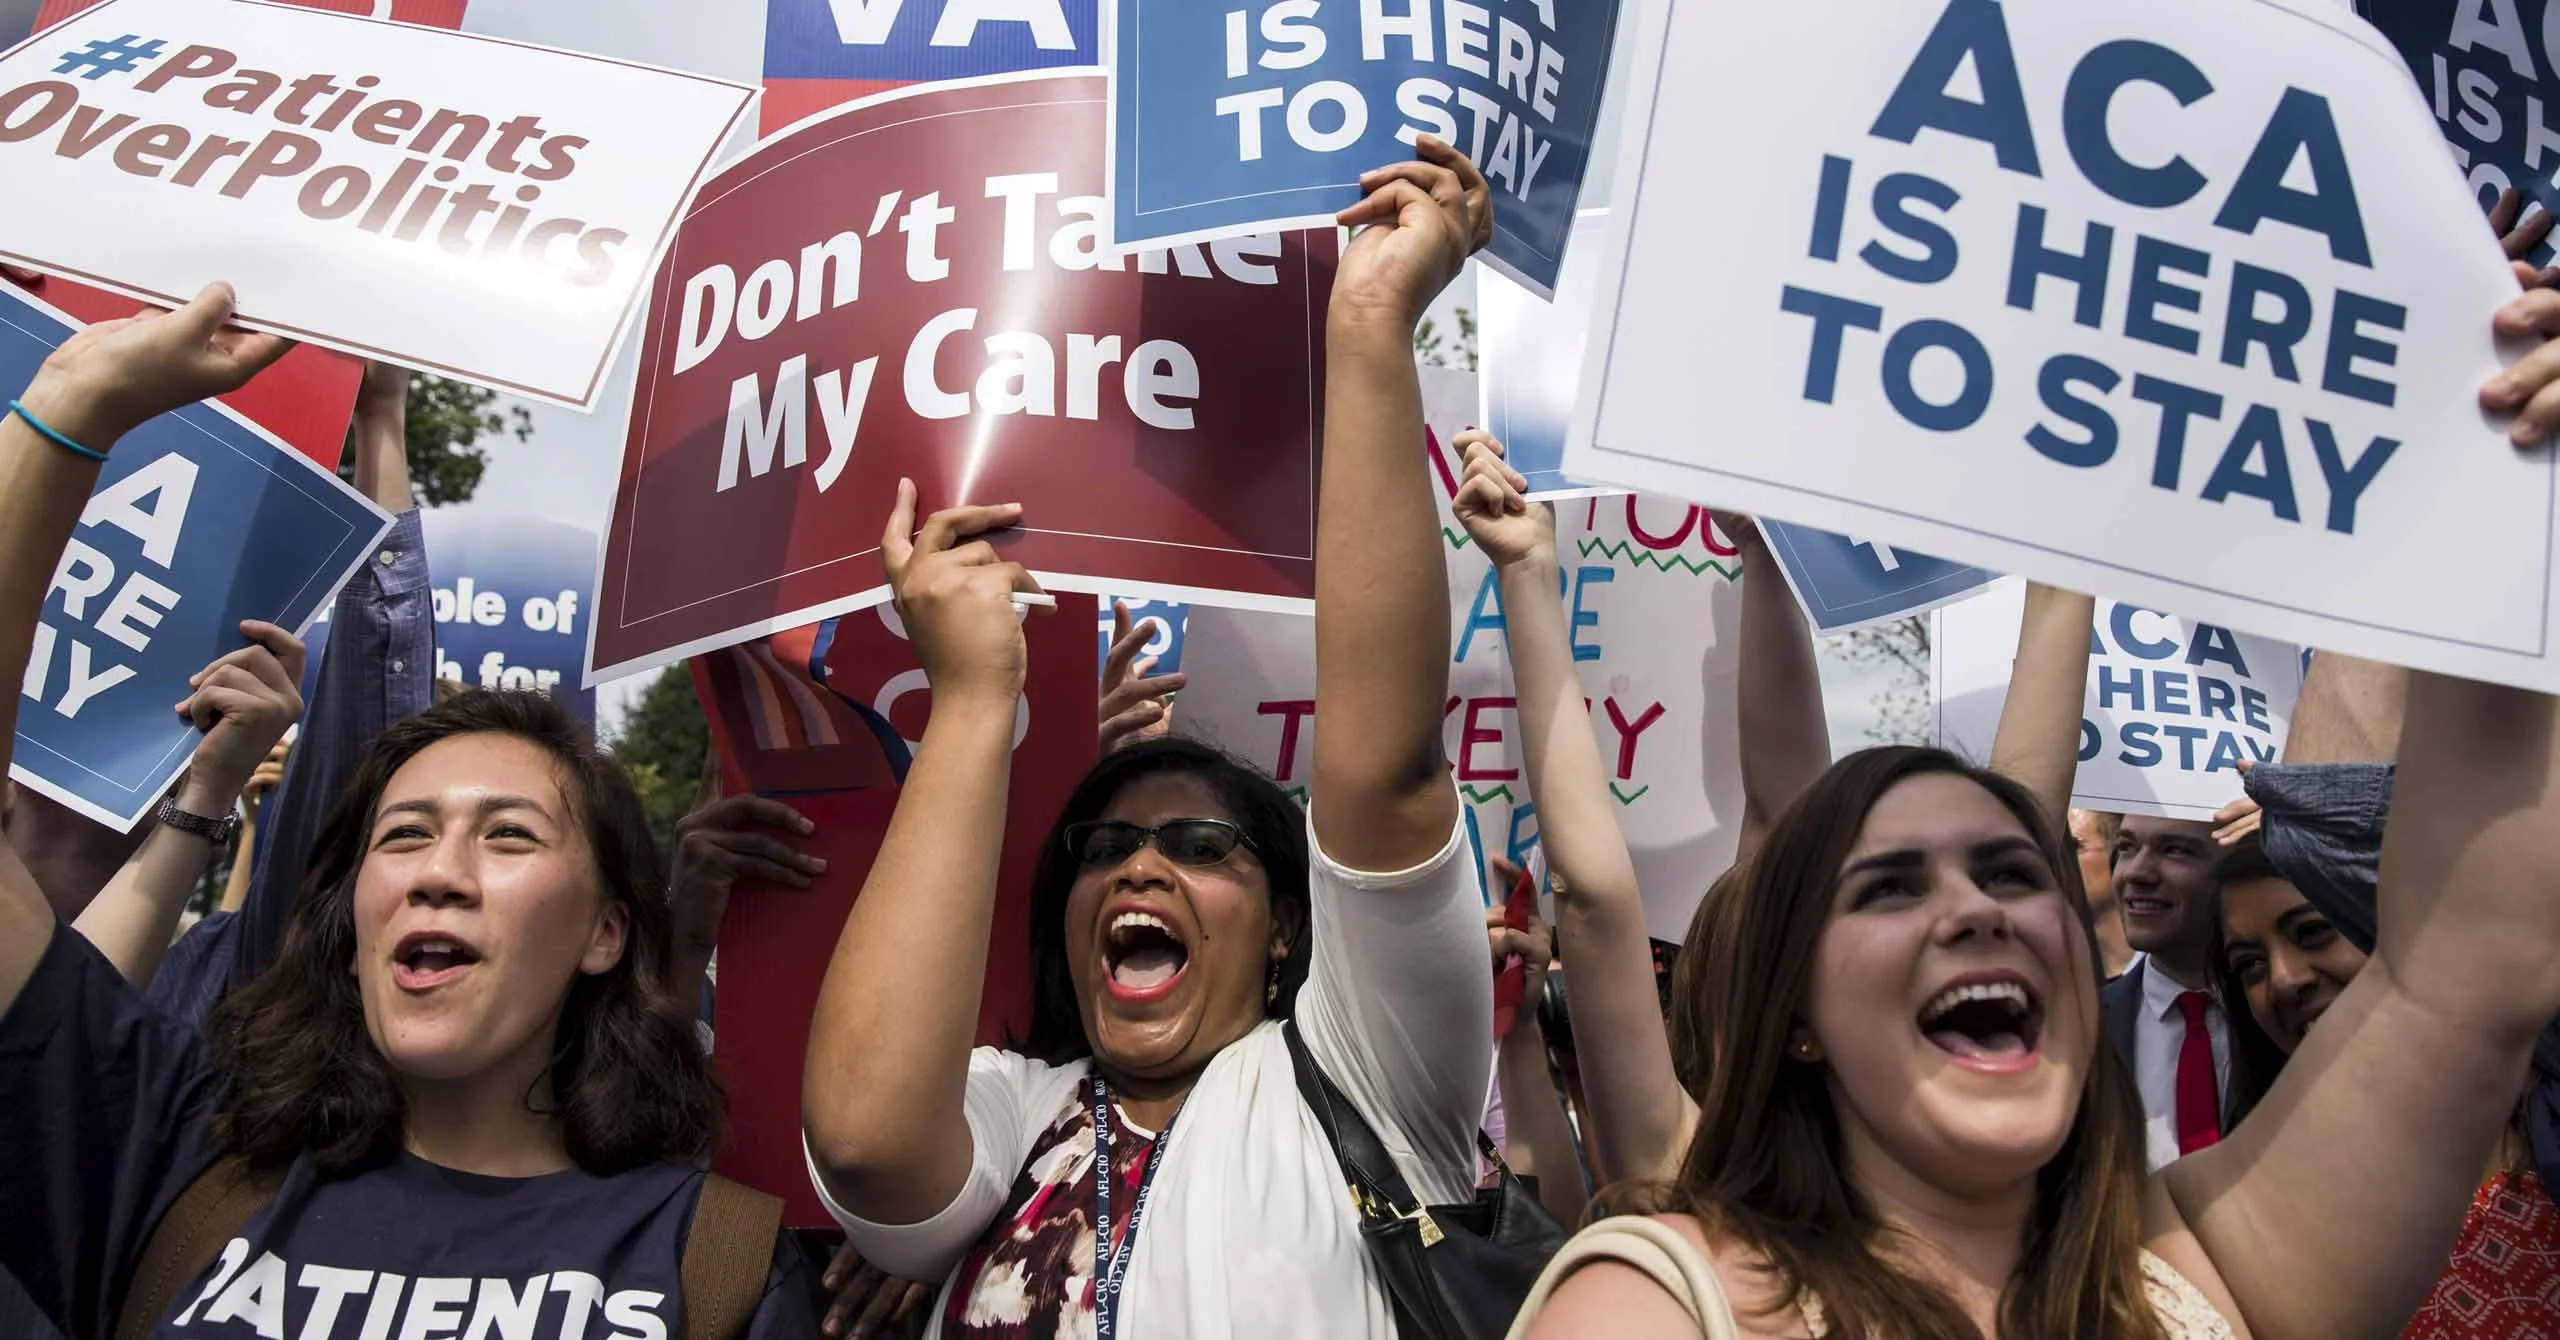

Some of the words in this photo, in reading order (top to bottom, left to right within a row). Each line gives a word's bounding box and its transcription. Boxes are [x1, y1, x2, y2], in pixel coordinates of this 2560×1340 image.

[51, 34, 591, 181] #Patients
[1226, 0, 1327, 79] IS
[1361, 0, 1565, 124] HERE
[2432, 52, 2503, 143] IS
[0, 80, 628, 286] OverPolitics
[1216, 80, 1368, 161] TO
[1395, 78, 1552, 202] STAY
[1868, 0, 2374, 268] ACA
[674, 190, 955, 375] Don't
[984, 172, 1282, 285] Tae
[1808, 153, 1961, 284] IS
[2006, 202, 2407, 407] HERE
[716, 353, 879, 493] My
[903, 307, 1200, 430] Care
[1780, 284, 1994, 432] TO
[2025, 353, 2402, 535] STAY
[523, 590, 578, 634] of
[1454, 563, 1615, 663] AE
[2099, 665, 2271, 734] HERE
[1096, 1104, 1108, 1140] AFL-CIO
[1097, 1154, 1109, 1198] AFL-CIO
[173, 1237, 668, 1340] PATIENTS
[1097, 1215, 1109, 1261] AFL-CIO
[1109, 1245, 1131, 1294] AFL-CIO
[1096, 1278, 1110, 1336] AFL-CIO
